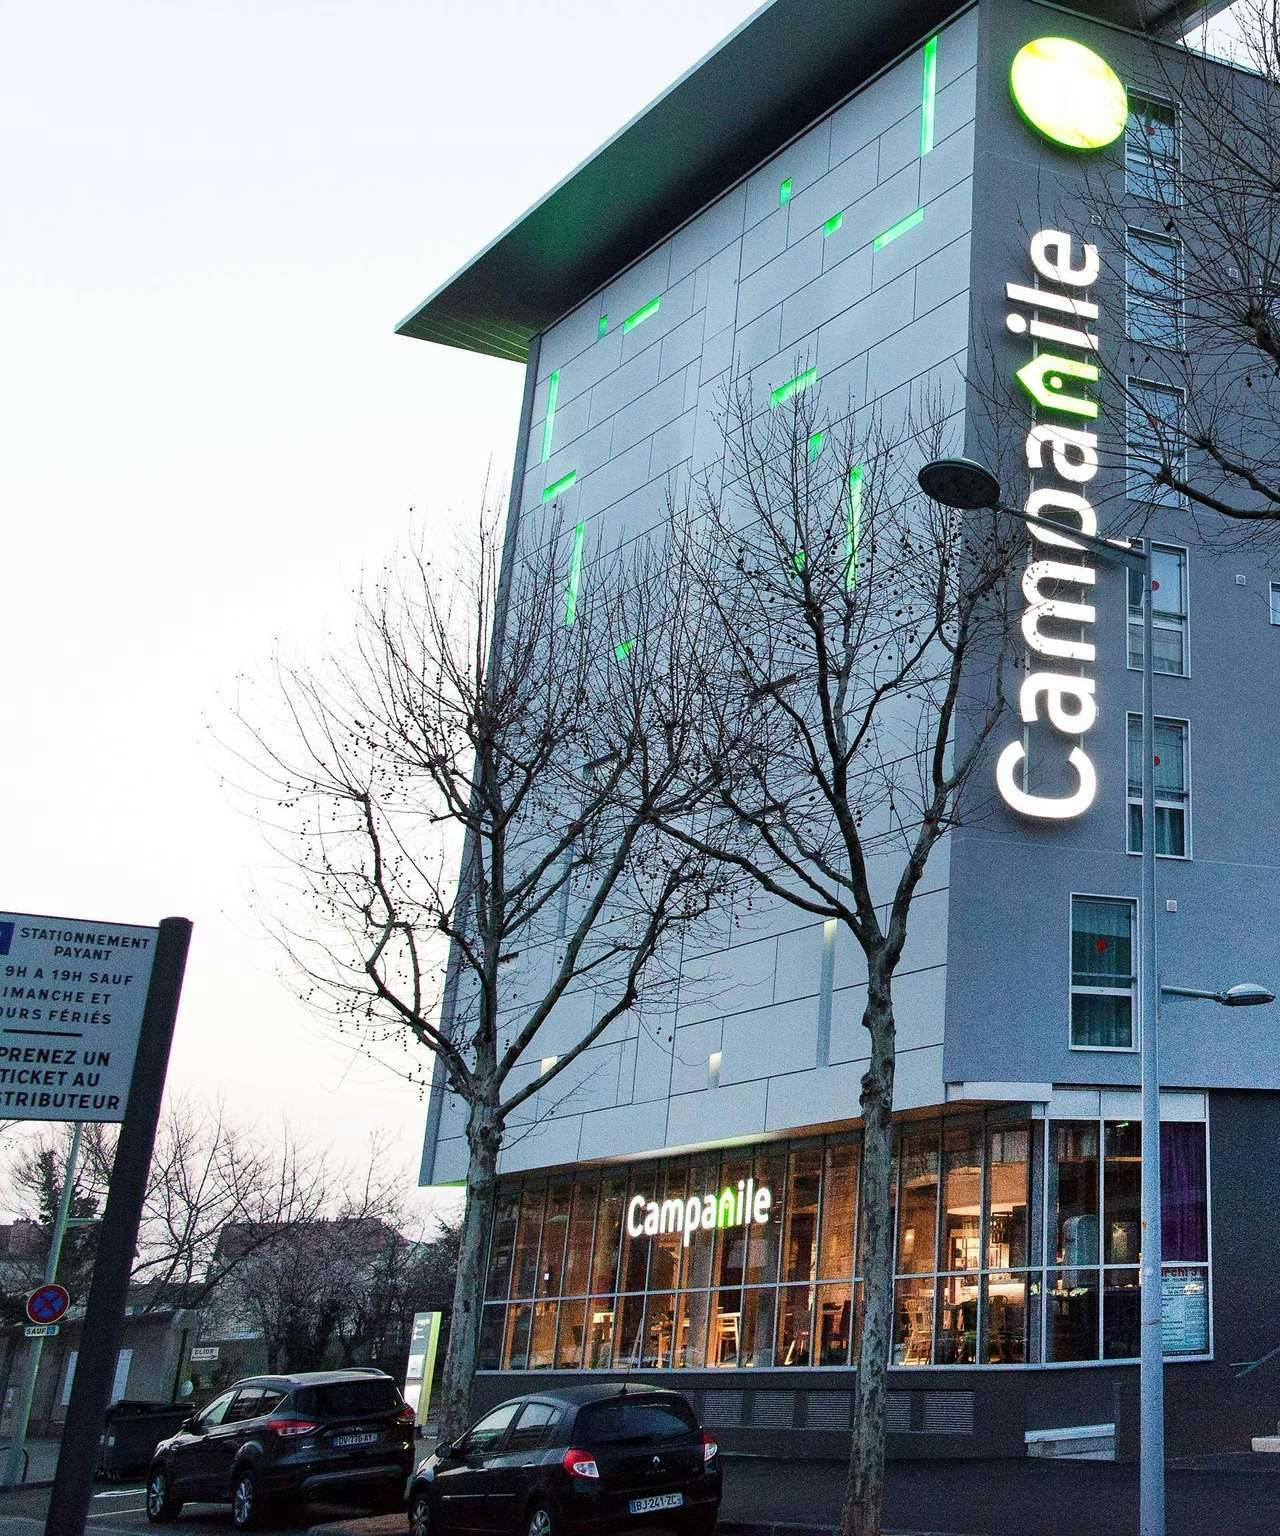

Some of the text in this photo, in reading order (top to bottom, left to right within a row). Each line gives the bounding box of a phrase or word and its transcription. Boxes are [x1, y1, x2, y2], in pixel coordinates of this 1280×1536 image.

[995, 228, 1132, 821] Campanile
[20, 927, 150, 949] STATIONNEMENT
[54, 945, 113, 961] PAYANT
[5, 966, 134, 986] 9H A 19H SAUF
[91, 992, 112, 1005] ET
[49, 1008, 112, 1025] FÉRIÉS
[0, 1047, 111, 1067] PRENEZ UN
[0, 1068, 100, 1087] TICKET AU
[0, 1091, 120, 1110] TRIBUTEUR
[627, 1178, 771, 1248] Campanile
[26, 1327, 46, 1335] SAUF
